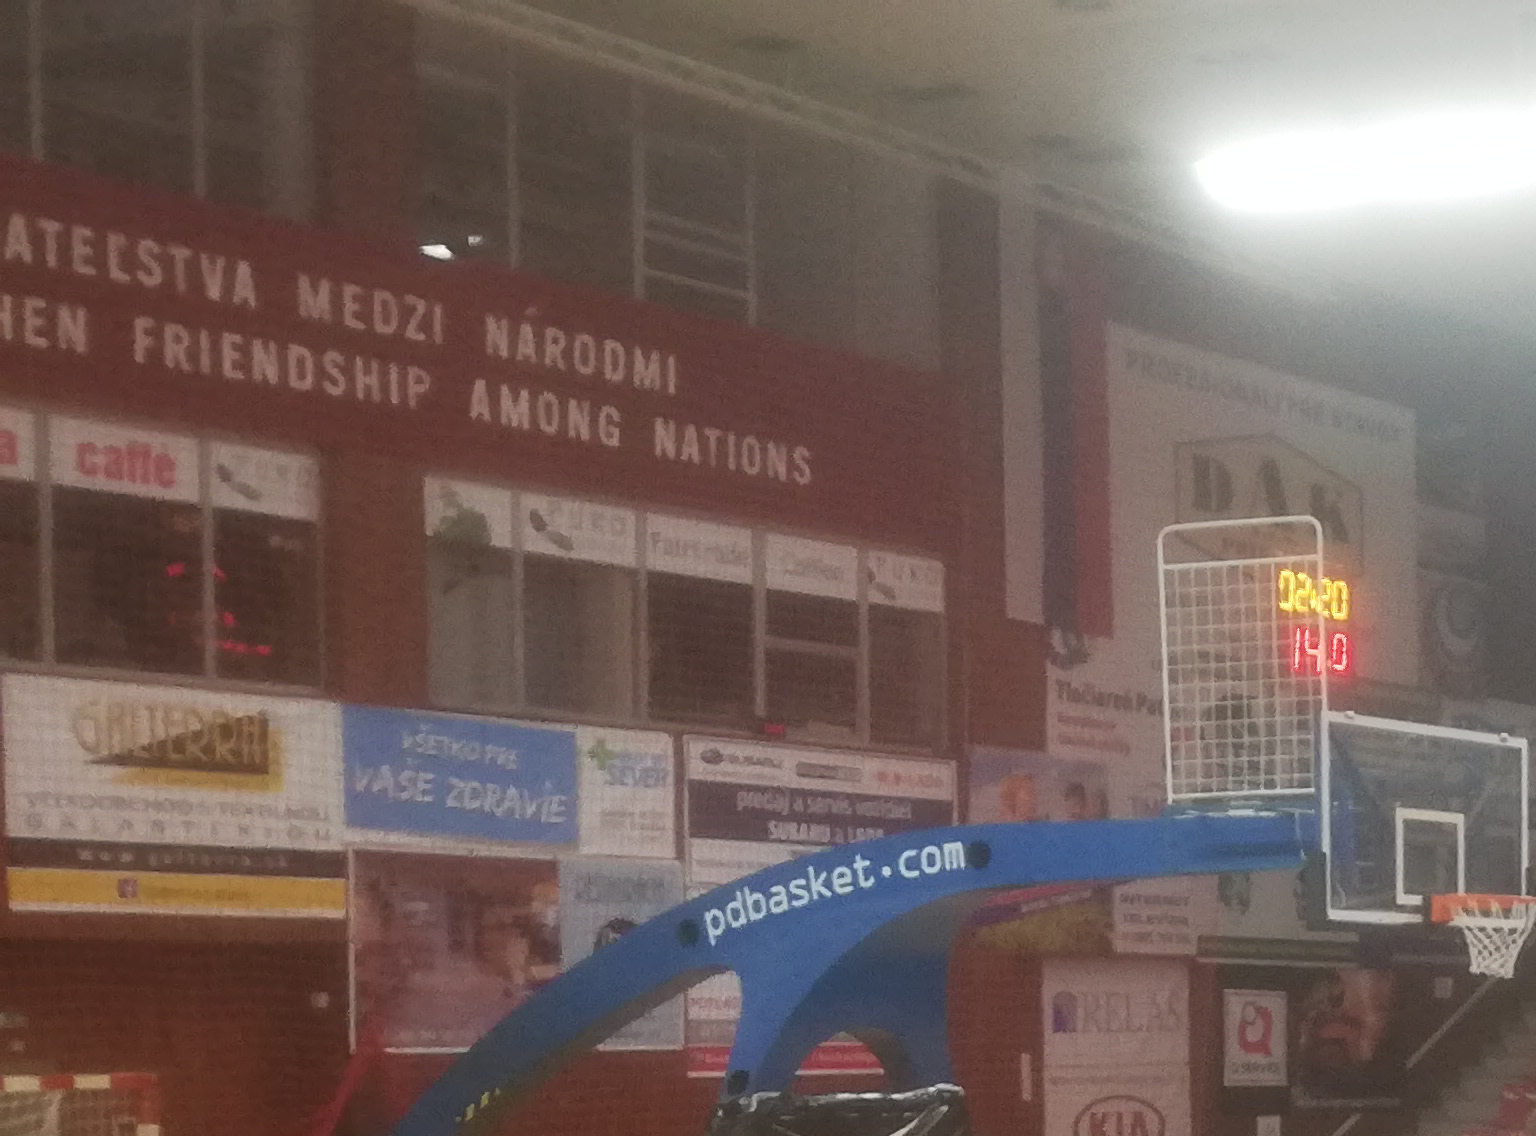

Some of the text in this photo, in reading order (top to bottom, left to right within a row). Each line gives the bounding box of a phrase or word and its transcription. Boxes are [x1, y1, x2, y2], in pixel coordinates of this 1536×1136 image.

[298, 272, 444, 345] MEDZI
[485, 306, 677, 396] NÁRODMI
[133, 315, 432, 410] FRIENDSHIP
[469, 378, 622, 448] AMONG
[653, 416, 812, 485] NATIONS
[354, 756, 437, 804] VAŠE
[704, 841, 966, 947] pdbasket.com
